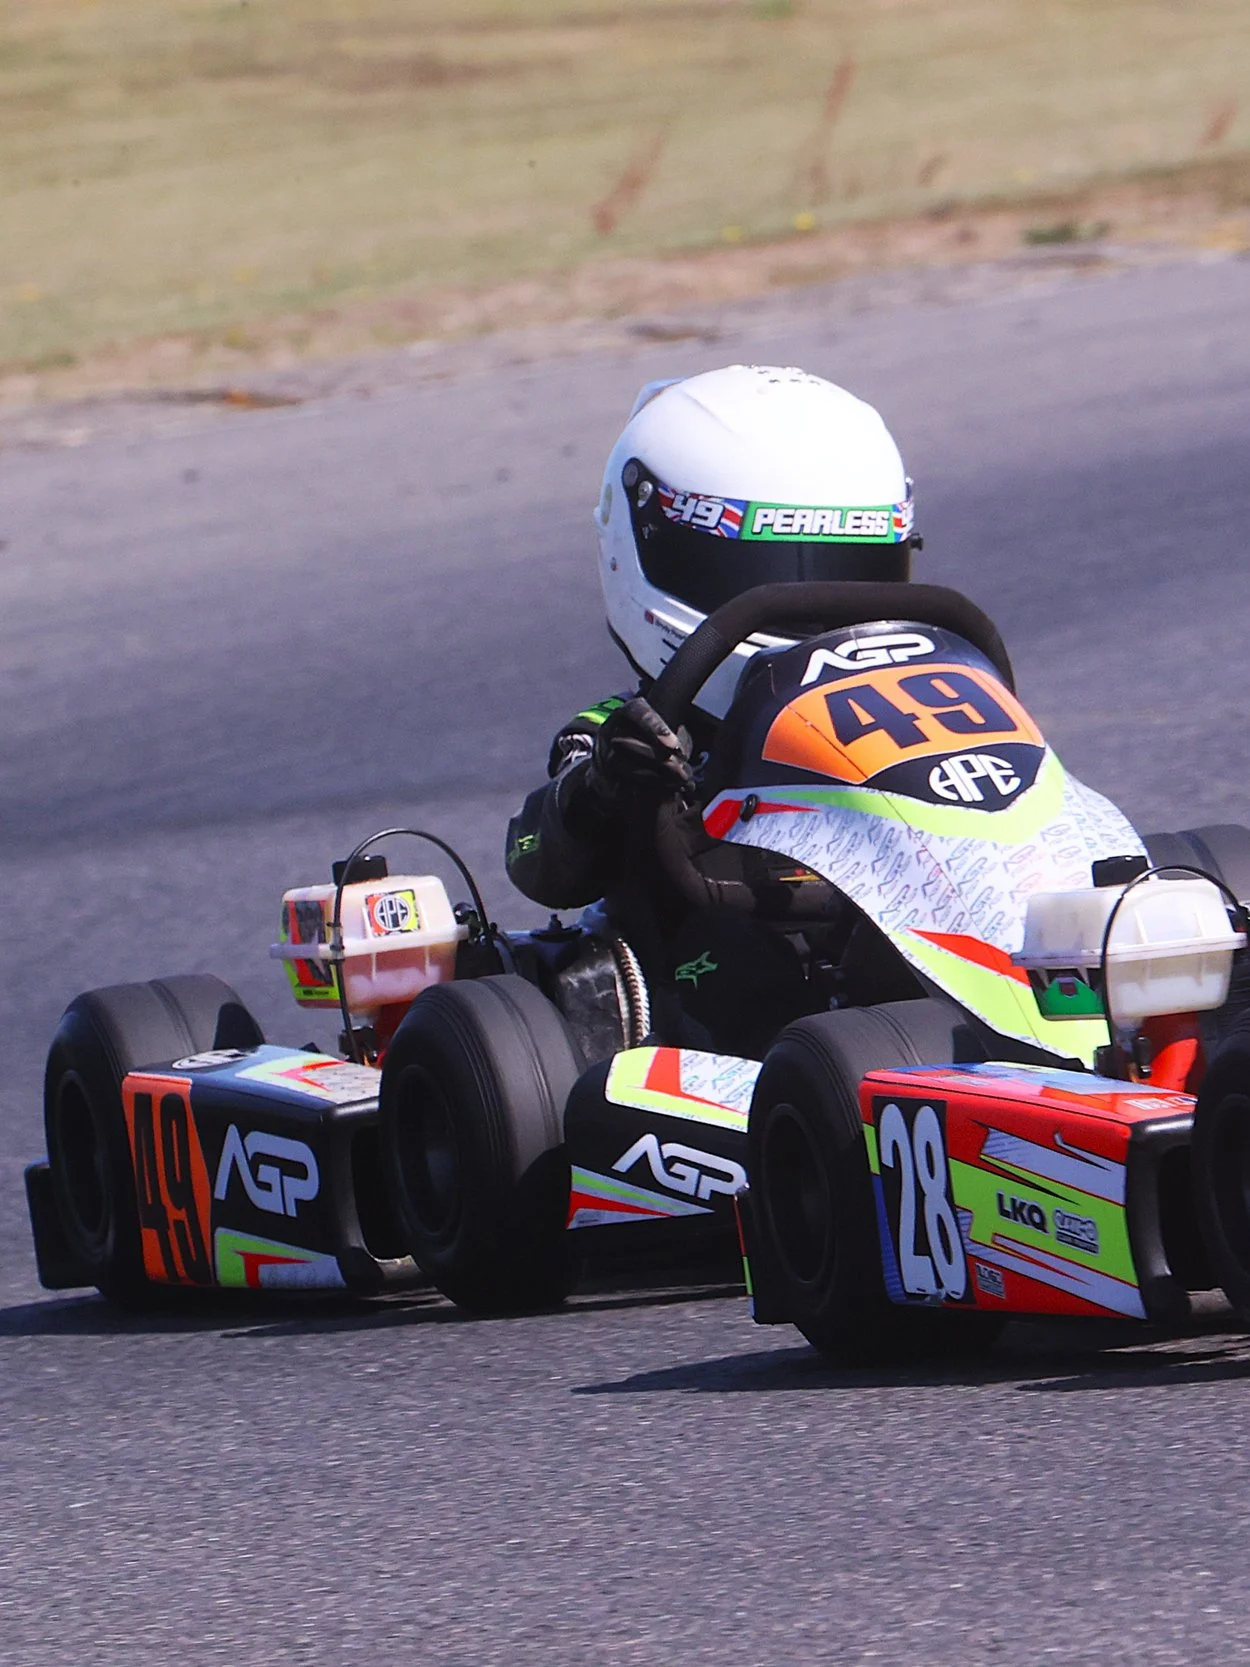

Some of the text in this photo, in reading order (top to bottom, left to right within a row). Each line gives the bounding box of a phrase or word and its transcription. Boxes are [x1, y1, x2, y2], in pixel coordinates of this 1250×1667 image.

[670, 493, 726, 528] 49
[800, 632, 936, 686] AGP
[823, 671, 1019, 749] 49
[133, 1093, 213, 1285] 49
[214, 1124, 320, 1218] AGP
[611, 1133, 748, 1201] AGP
[879, 1103, 967, 1300] 28
[997, 1192, 1049, 1234] LKQ
